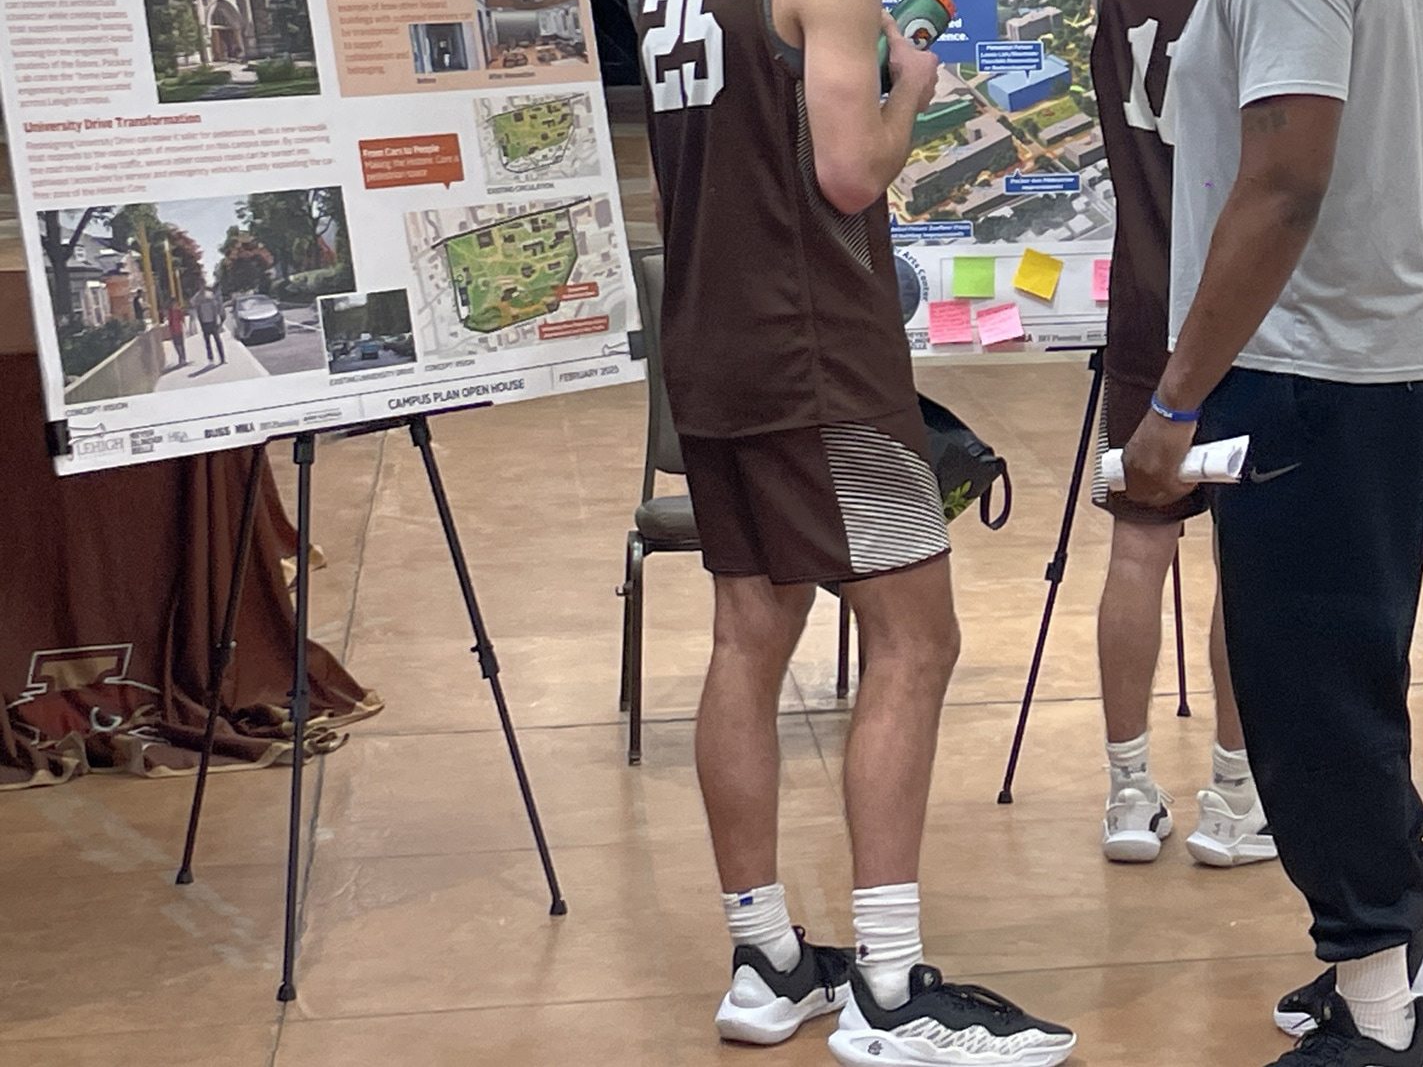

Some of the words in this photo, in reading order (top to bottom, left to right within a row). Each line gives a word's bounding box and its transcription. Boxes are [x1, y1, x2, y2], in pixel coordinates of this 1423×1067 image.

[23, 119, 82, 133] University
[85, 118, 113, 131] Drive
[117, 113, 201, 128] Transformation
[902, 251, 920, 269] Arts
[918, 268, 930, 302] Center
[559, 369, 598, 382] FEBRUARY
[389, 394, 431, 409] CAMPUS
[434, 390, 461, 402] PLAN
[462, 385, 490, 399] OPEN
[491, 379, 525, 394] HOUSE
[76, 437, 124, 457] LEHIGH
